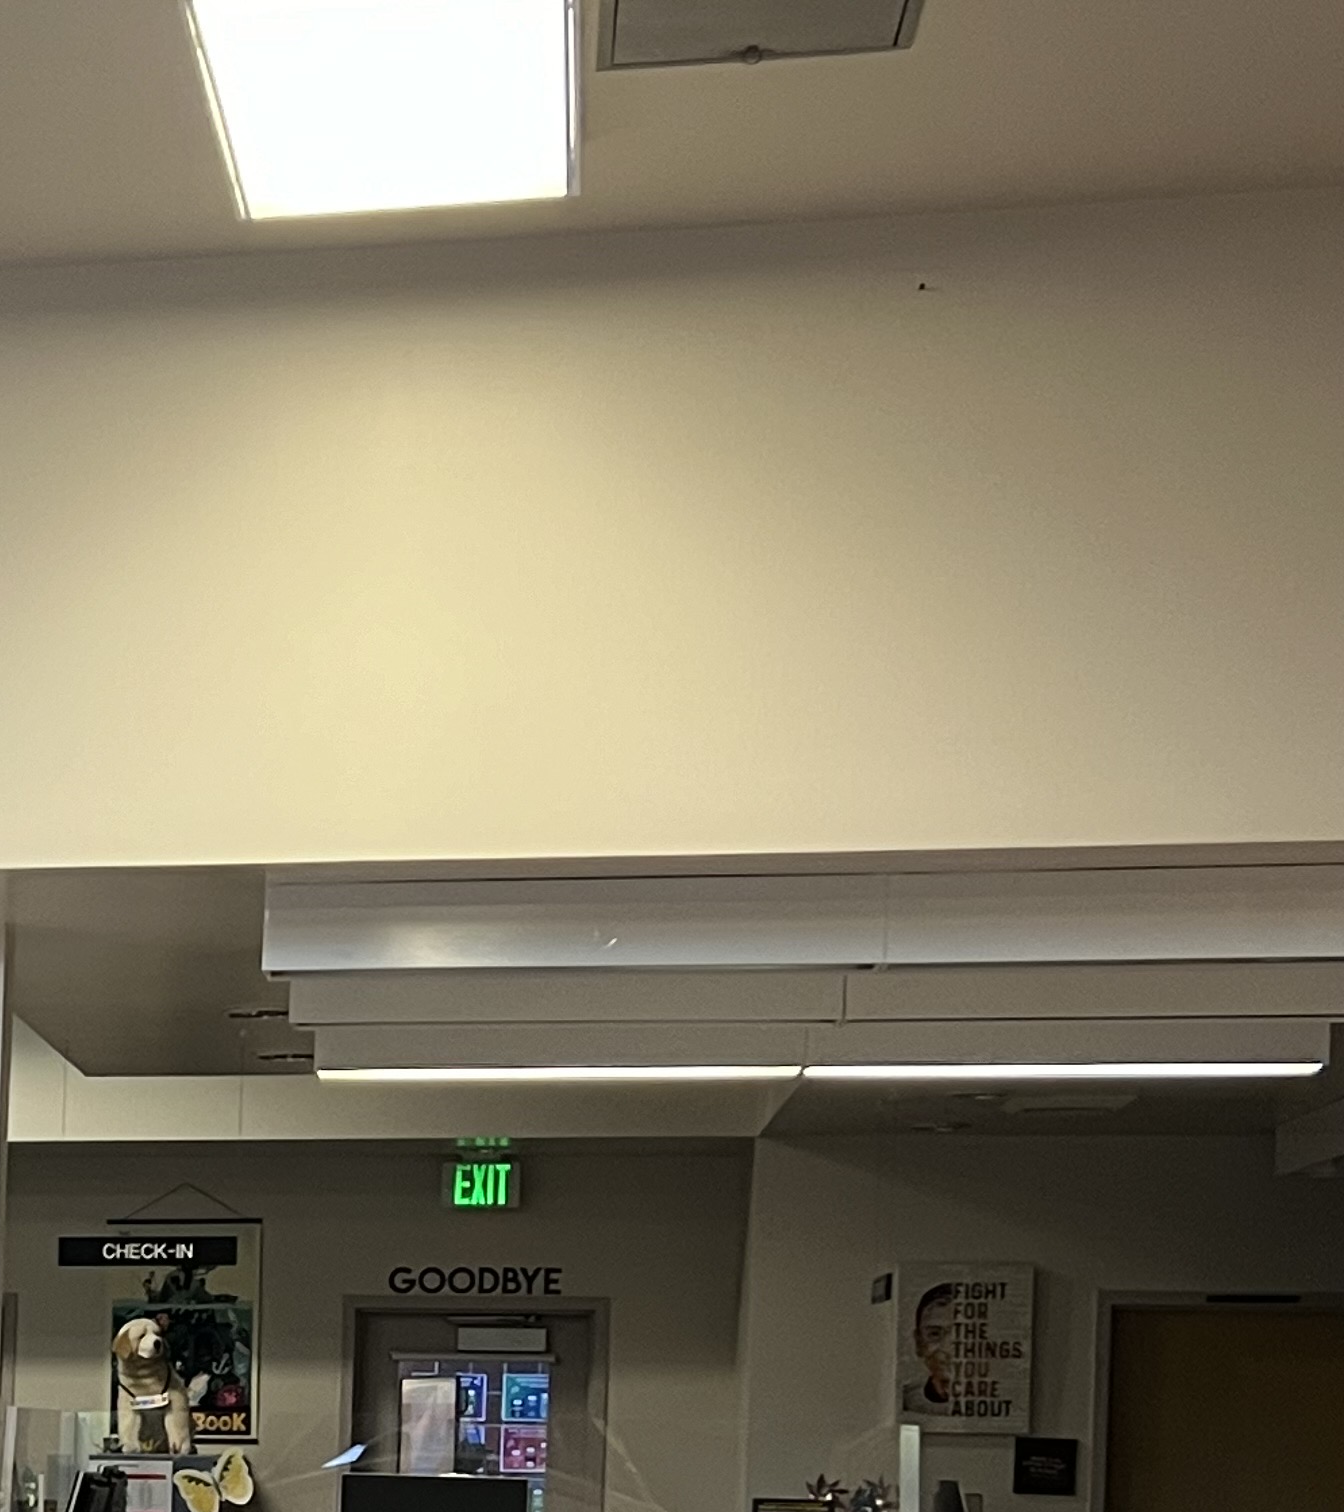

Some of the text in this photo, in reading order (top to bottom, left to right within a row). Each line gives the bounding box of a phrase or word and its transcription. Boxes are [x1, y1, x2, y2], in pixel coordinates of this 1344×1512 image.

[454, 1163, 511, 1205] EXIT
[102, 1242, 194, 1260] CHECK-IN
[388, 1266, 563, 1295] GOODBYE
[953, 1282, 1008, 1300] FIGHT
[953, 1302, 988, 1319] FOR
[953, 1322, 988, 1339] THE
[952, 1341, 1023, 1359] THINGS
[953, 1361, 990, 1378] YOU
[952, 1381, 1000, 1398] CARE
[952, 1400, 1012, 1417] ABOUT
